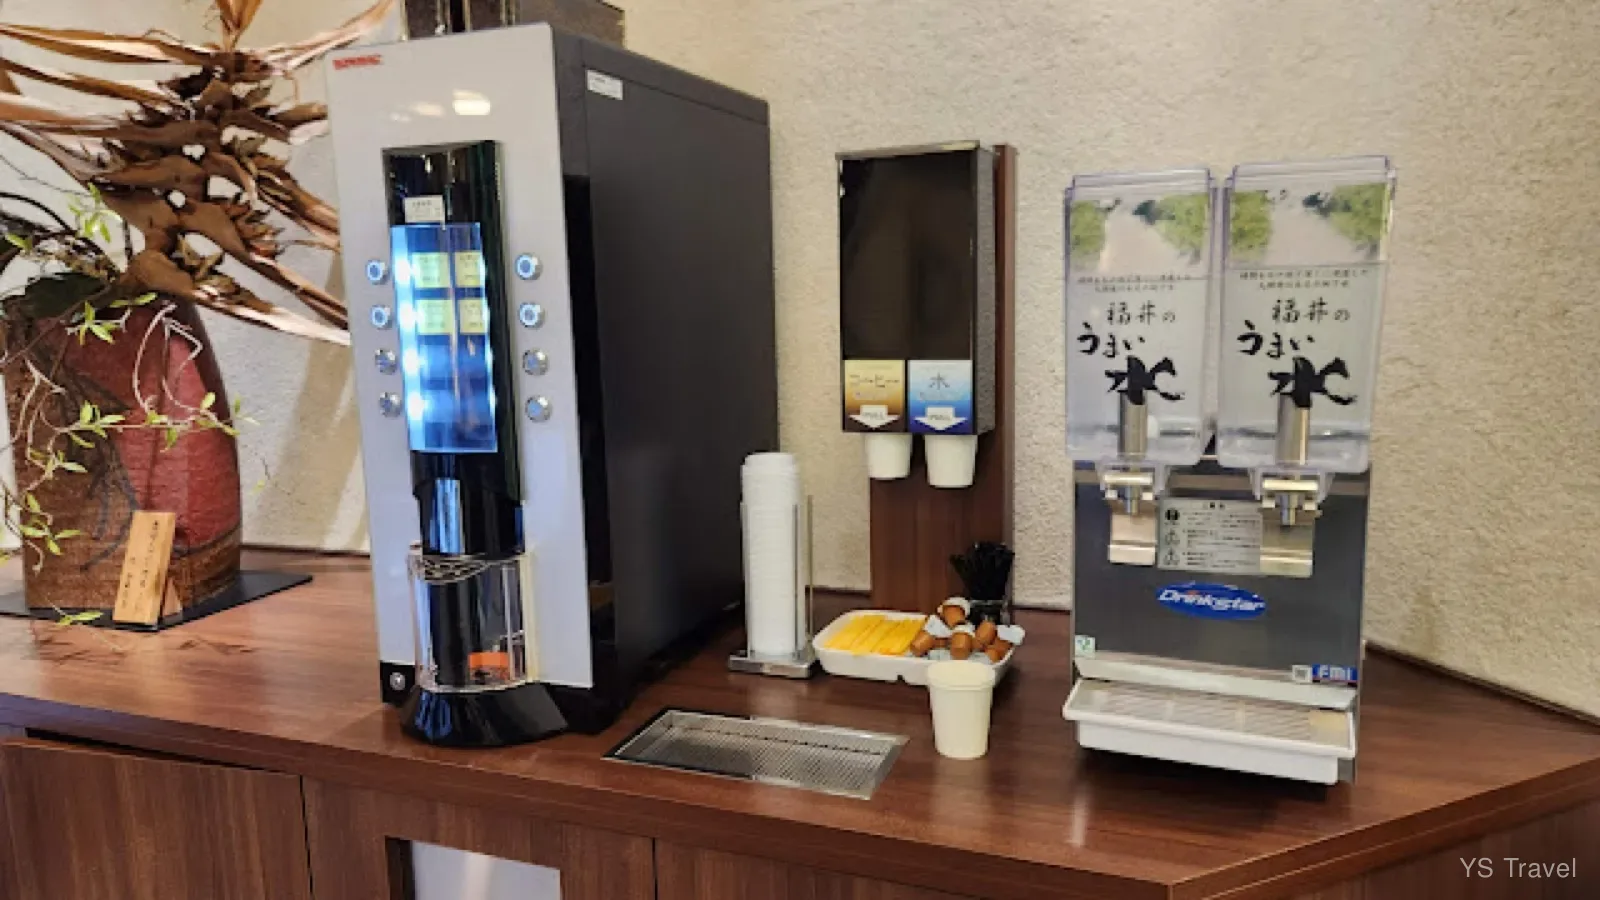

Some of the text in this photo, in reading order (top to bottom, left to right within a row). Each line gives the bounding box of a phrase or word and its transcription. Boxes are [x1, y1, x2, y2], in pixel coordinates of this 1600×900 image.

[1106, 301, 1176, 325] 福井の
[1272, 297, 1350, 323] 福井の
[1077, 321, 1145, 358] うまい
[1237, 319, 1315, 358] うまい
[928, 371, 951, 391] 水
[1104, 354, 1185, 405] 水
[1267, 355, 1357, 408] 水
